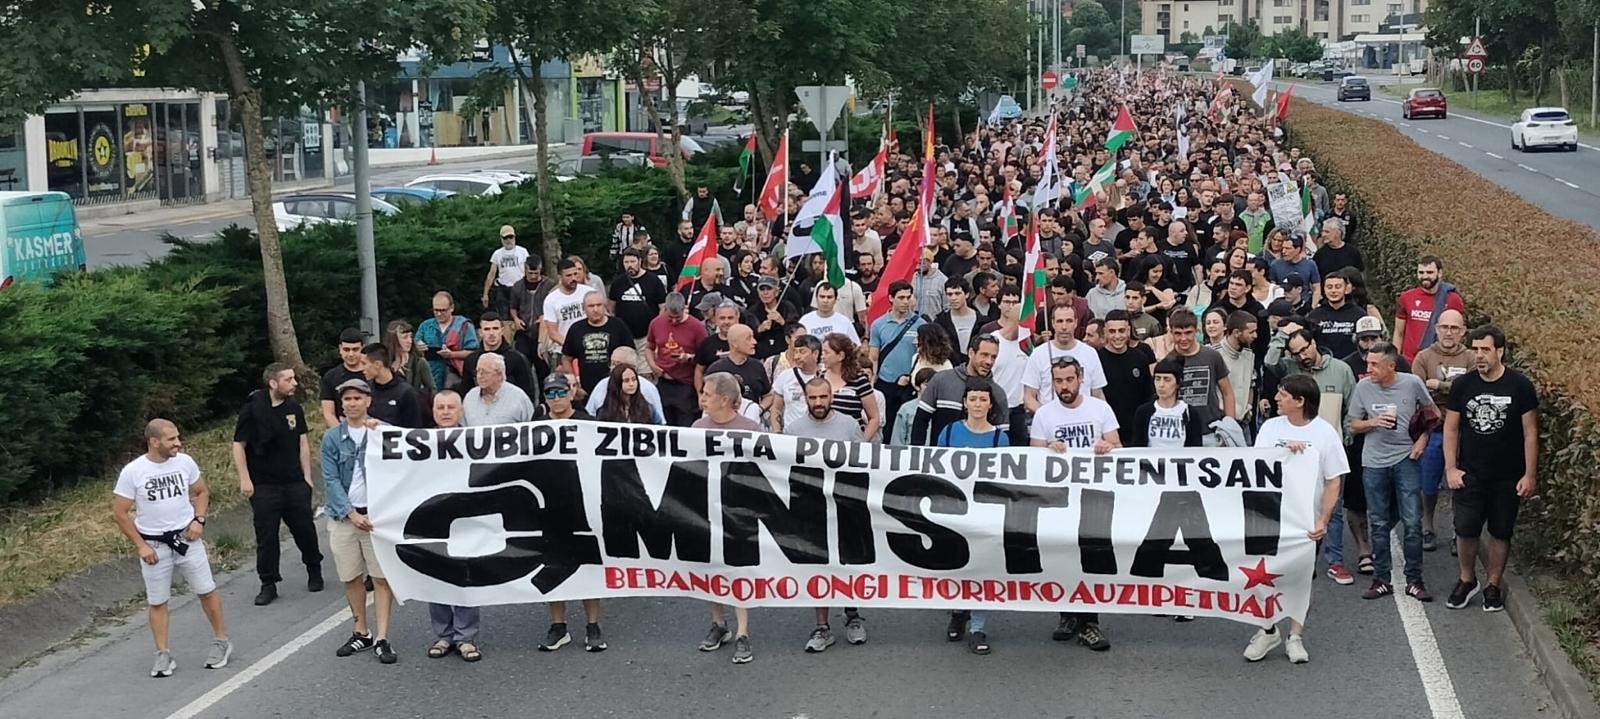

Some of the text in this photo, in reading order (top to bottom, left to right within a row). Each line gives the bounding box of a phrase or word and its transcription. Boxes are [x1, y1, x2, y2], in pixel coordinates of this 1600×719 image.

[14, 232, 73, 261] KASMER
[381, 425, 578, 461] ESKUBIDE
[595, 427, 687, 458] ZIBIL
[705, 430, 777, 460] ETA
[796, 437, 1027, 480] POLITIKOEN
[1045, 455, 1283, 488] DEFENTSAN
[604, 566, 1283, 619] BERANGOKO ONGI ETORRIKO AUZIPETUAK
